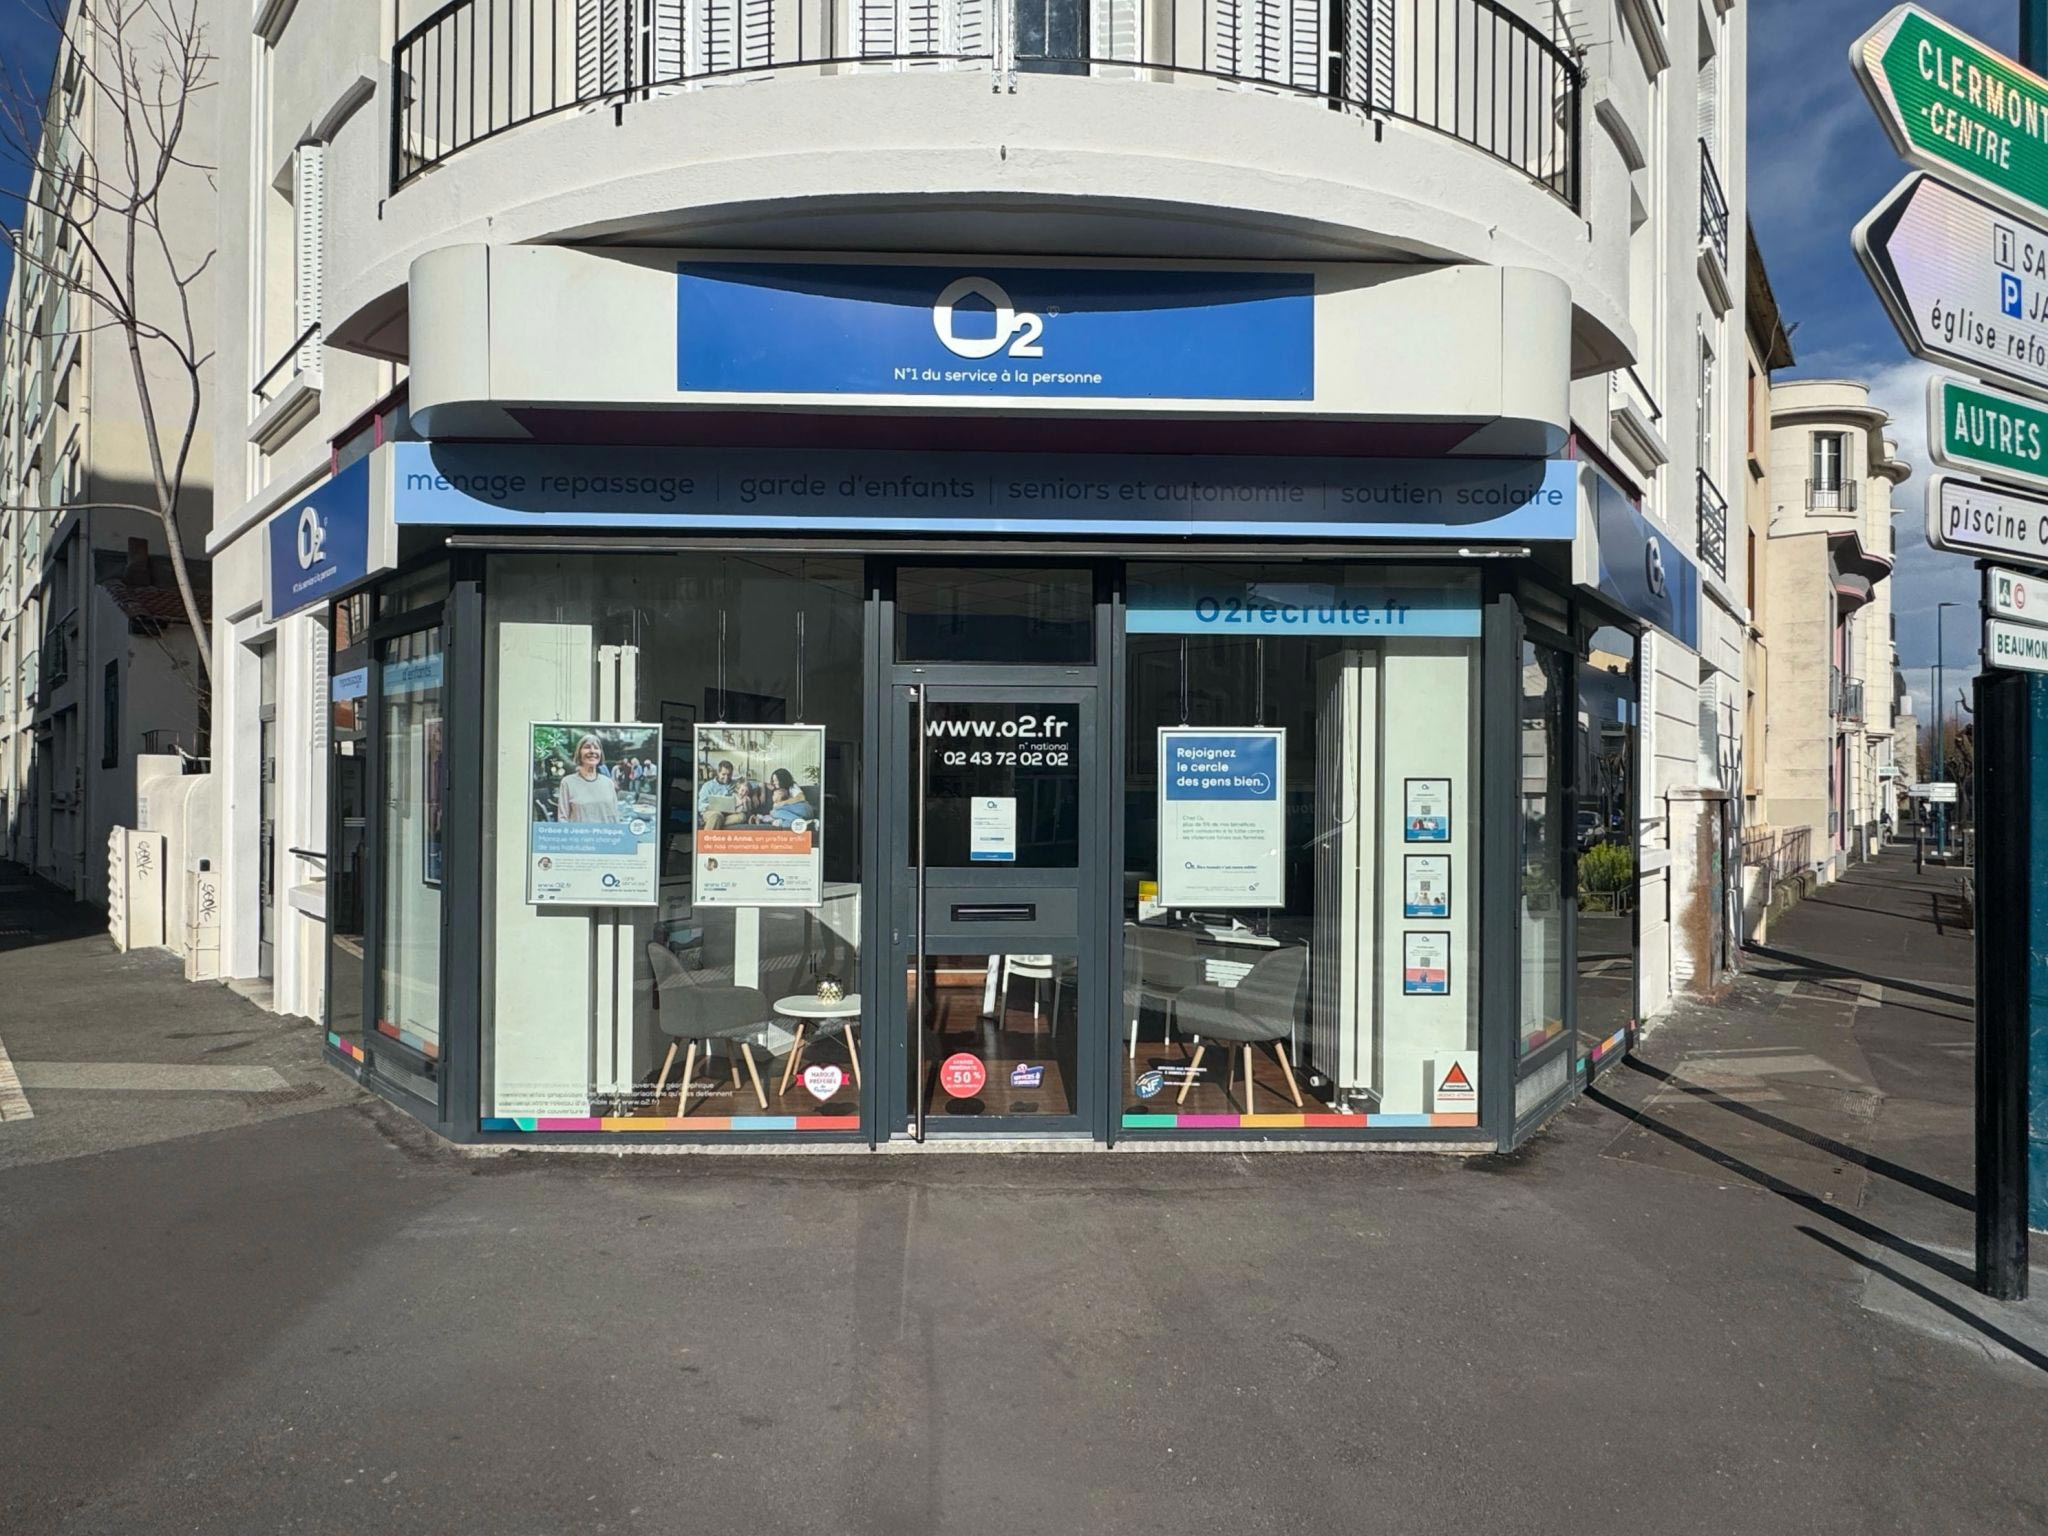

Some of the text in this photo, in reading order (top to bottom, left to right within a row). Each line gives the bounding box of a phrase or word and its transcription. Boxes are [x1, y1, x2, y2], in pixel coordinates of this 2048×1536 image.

[2022, 243, 2046, 280] SA
[1931, 299, 1996, 349] église
[922, 368, 941, 381] du
[945, 369, 998, 382] service
[1001, 370, 1011, 382] à
[1015, 370, 1029, 382] la
[1032, 372, 1103, 386] personne
[1954, 402, 2041, 460] AUTRES
[406, 468, 1563, 506] ménage repassage garde d'enfants seniors et autonomie soutien scolaire
[1950, 499, 2026, 541] piscine
[1195, 595, 1410, 626] O2recrute.fr
[926, 715, 1069, 738] www.o2.fr
[1031, 742, 1069, 751] national
[1176, 747, 1237, 759] Rejoignez
[943, 751, 1069, 766] 02 43 72 02 02
[1176, 761, 1229, 772] le cercle
[1176, 776, 1264, 789] des gens bien.
[1140, 1078, 1160, 1094] NF
